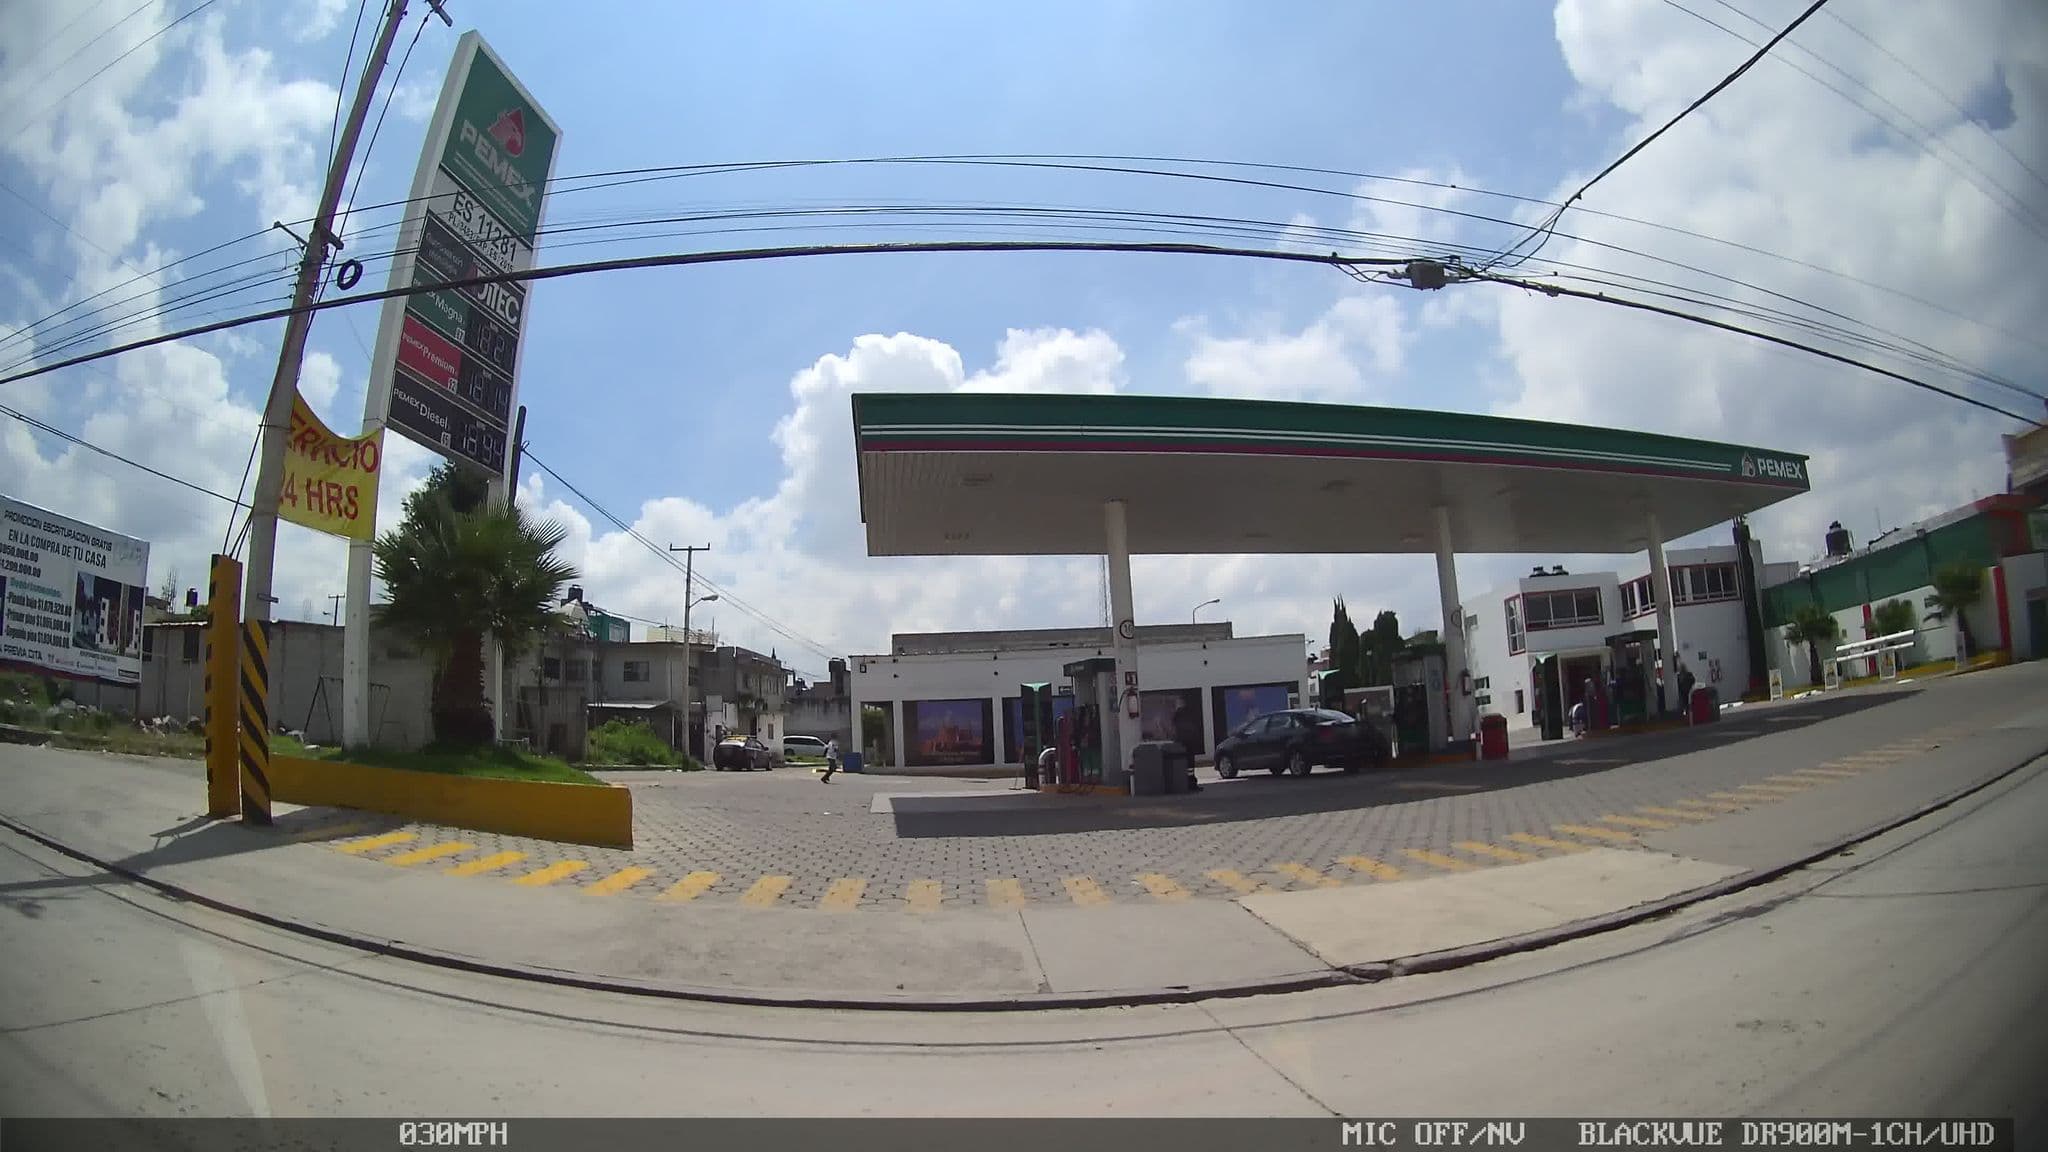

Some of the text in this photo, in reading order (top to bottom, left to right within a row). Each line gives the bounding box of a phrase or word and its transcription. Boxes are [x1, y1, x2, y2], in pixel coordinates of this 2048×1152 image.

[460, 119, 536, 206] PEMEX
[453, 189, 473, 223] ES
[478, 212, 517, 263] 11281
[435, 294, 464, 324] Magna
[422, 344, 456, 376] Premium
[393, 387, 420, 410] PEMEX
[419, 403, 449, 430] Diesel
[1757, 457, 1803, 480] PEMEX
[305, 477, 359, 521] HRS
[9, 528, 19, 543] EN
[20, 531, 29, 546] LA
[31, 534, 60, 556] COMPRA
[62, 544, 71, 558] DE
[73, 545, 84, 562] TU
[85, 550, 107, 569] CASA
[91, 537, 113, 552] GRATIS
[28, 648, 43, 661] CITA
